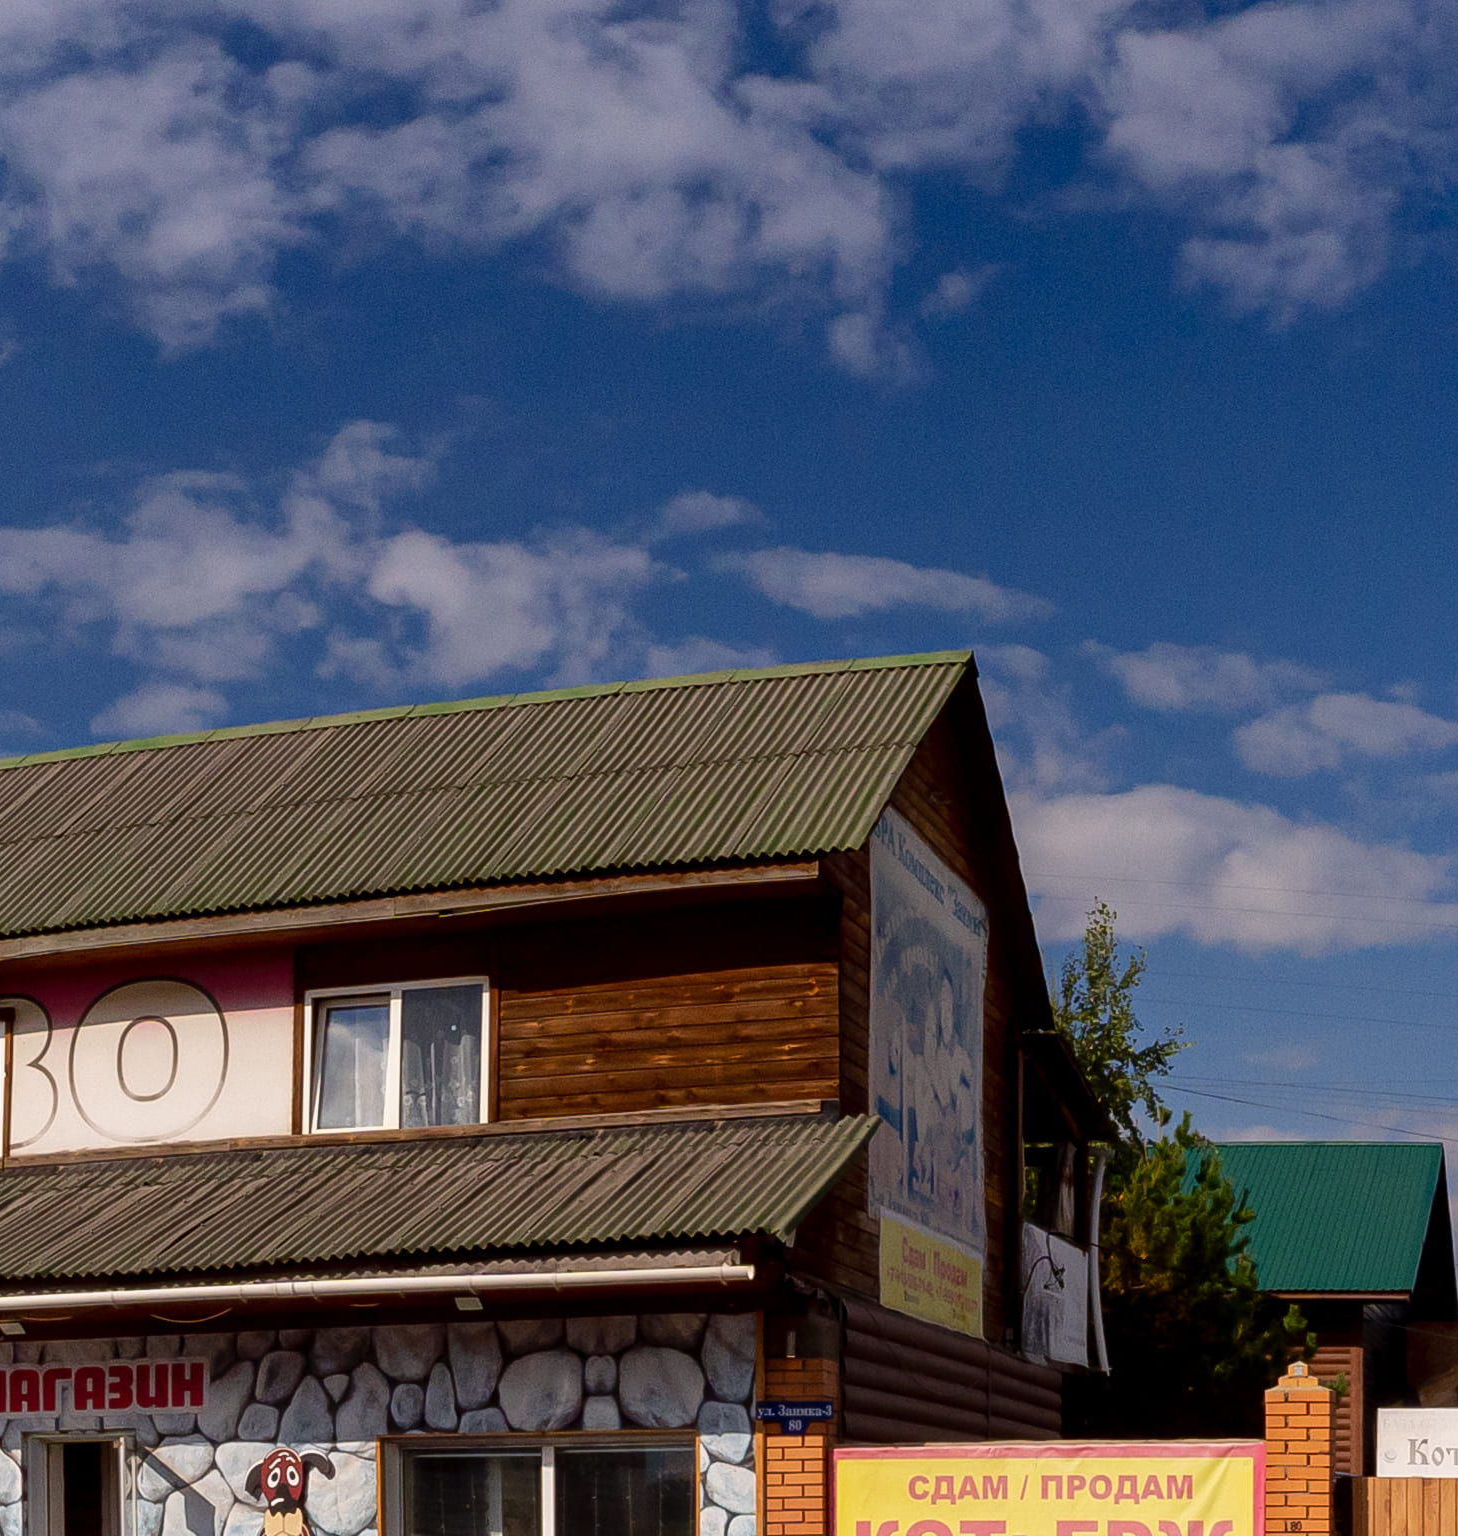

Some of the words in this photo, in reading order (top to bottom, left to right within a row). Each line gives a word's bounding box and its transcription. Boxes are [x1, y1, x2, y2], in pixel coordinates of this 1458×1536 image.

[788, 1420, 802, 1431] 80
[908, 1475, 1008, 1504] СДАМ
[1020, 1475, 1029, 1500] /
[1041, 1475, 1193, 1504] ПРОДАМ
